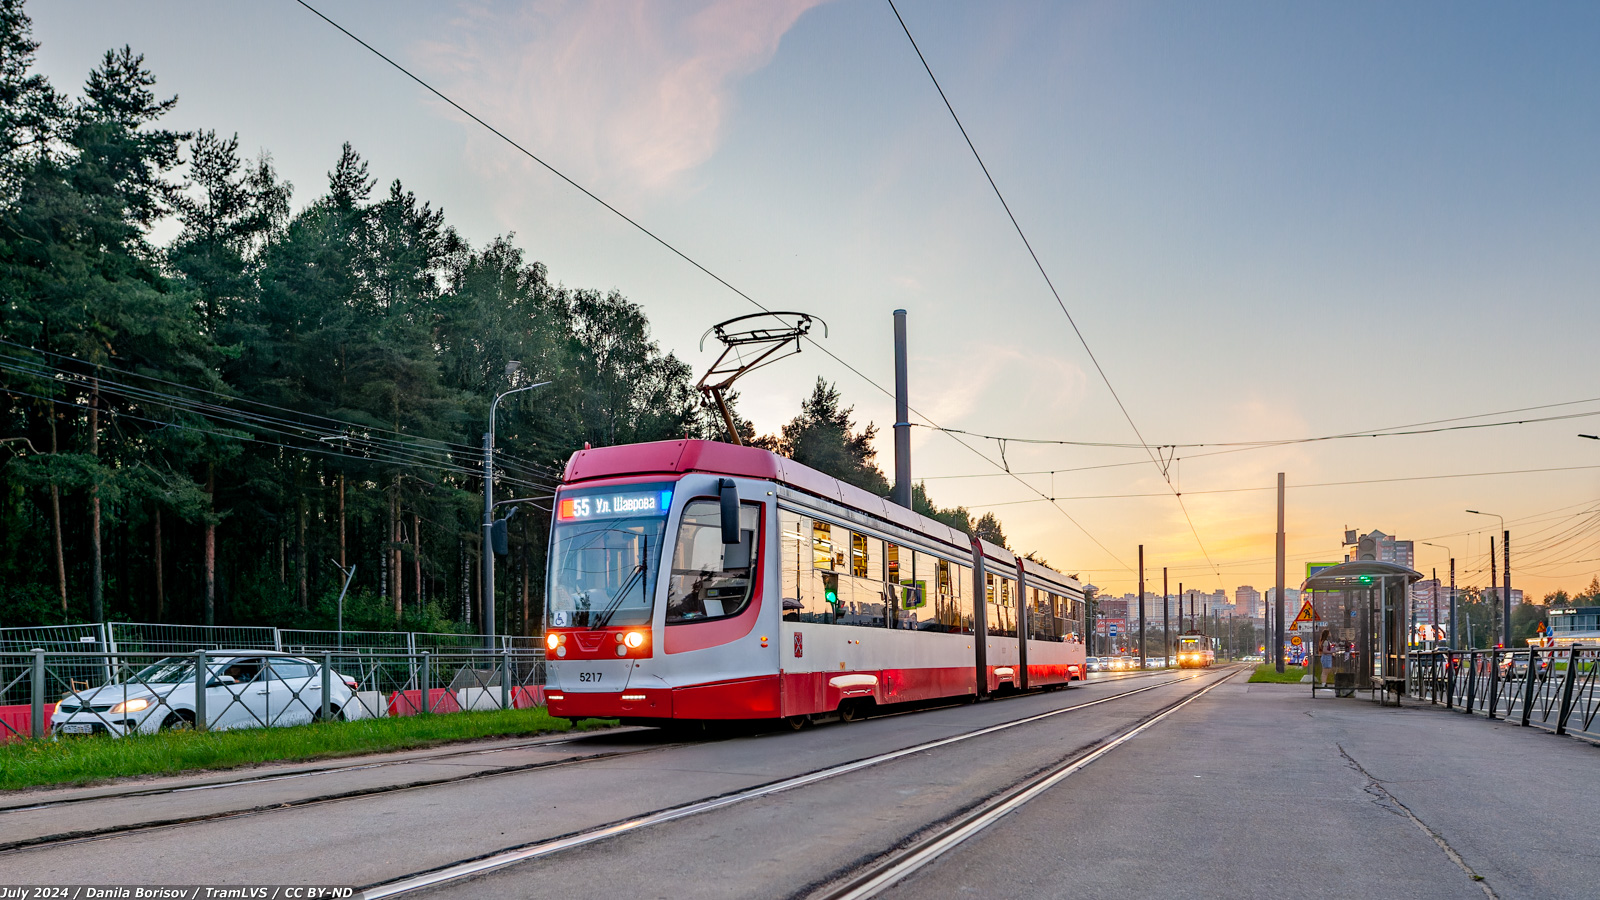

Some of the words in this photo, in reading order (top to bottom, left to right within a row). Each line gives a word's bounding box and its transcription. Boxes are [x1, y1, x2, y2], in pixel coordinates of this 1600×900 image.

[573, 498, 590, 517] 55
[596, 498, 611, 513] Ул.
[614, 496, 655, 511] Шаврова
[579, 672, 603, 683] 5217
